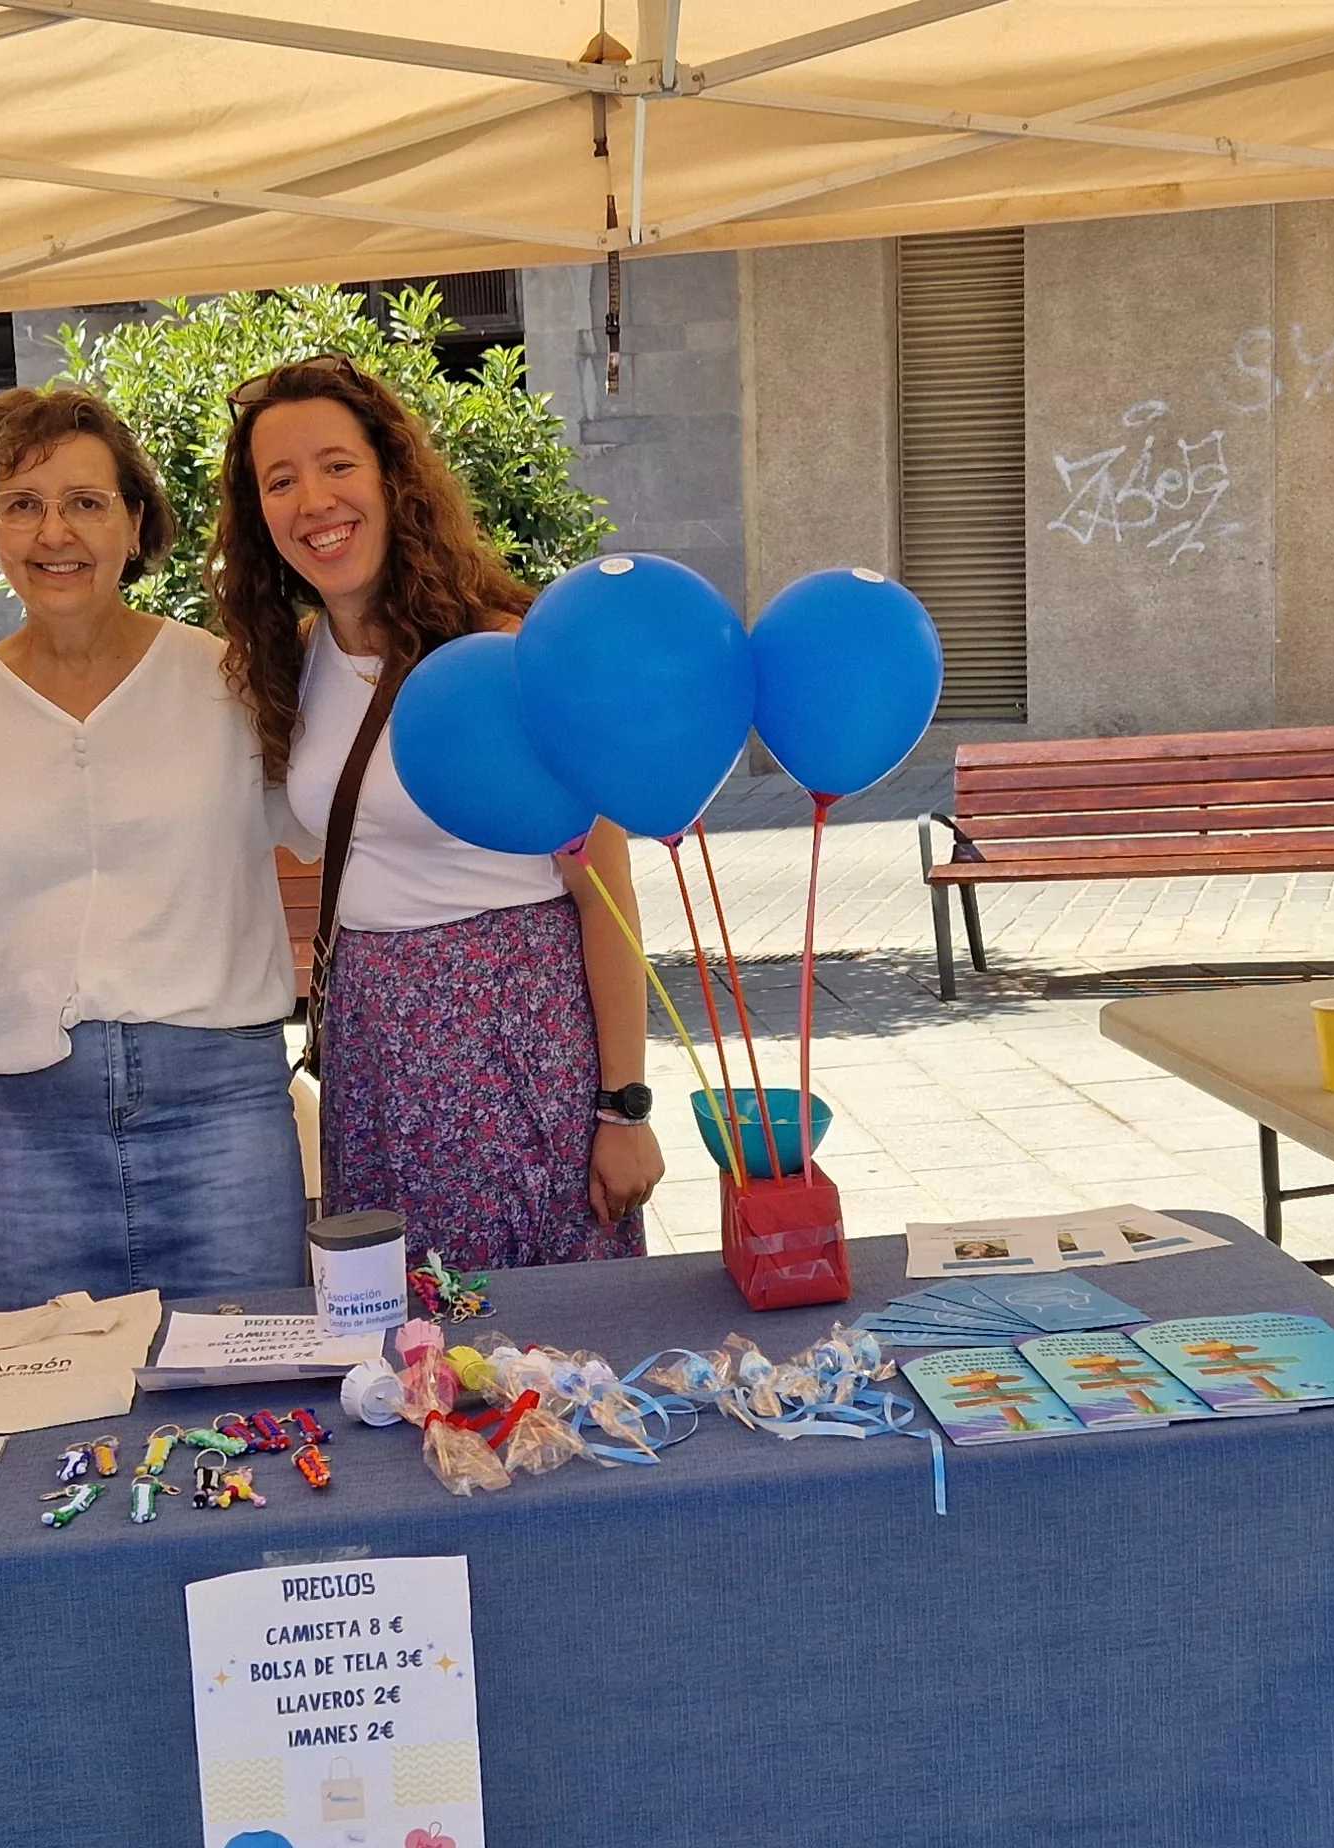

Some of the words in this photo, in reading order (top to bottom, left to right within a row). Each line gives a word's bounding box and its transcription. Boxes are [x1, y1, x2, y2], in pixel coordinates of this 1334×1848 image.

[281, 1572, 376, 1603] PRECIOS
[266, 1619, 362, 1646] CAMISETA
[369, 1618, 381, 1636] 8
[389, 1615, 405, 1635] €
[250, 1658, 307, 1683] BOLSA
[314, 1656, 335, 1677] DE
[343, 1651, 389, 1673] TELA
[396, 1648, 424, 1670] 3€
[276, 1689, 366, 1716] LLAVEROS
[373, 1685, 402, 1707] 2€
[287, 1724, 359, 1749] IMANES
[366, 1720, 396, 1743] 2€
